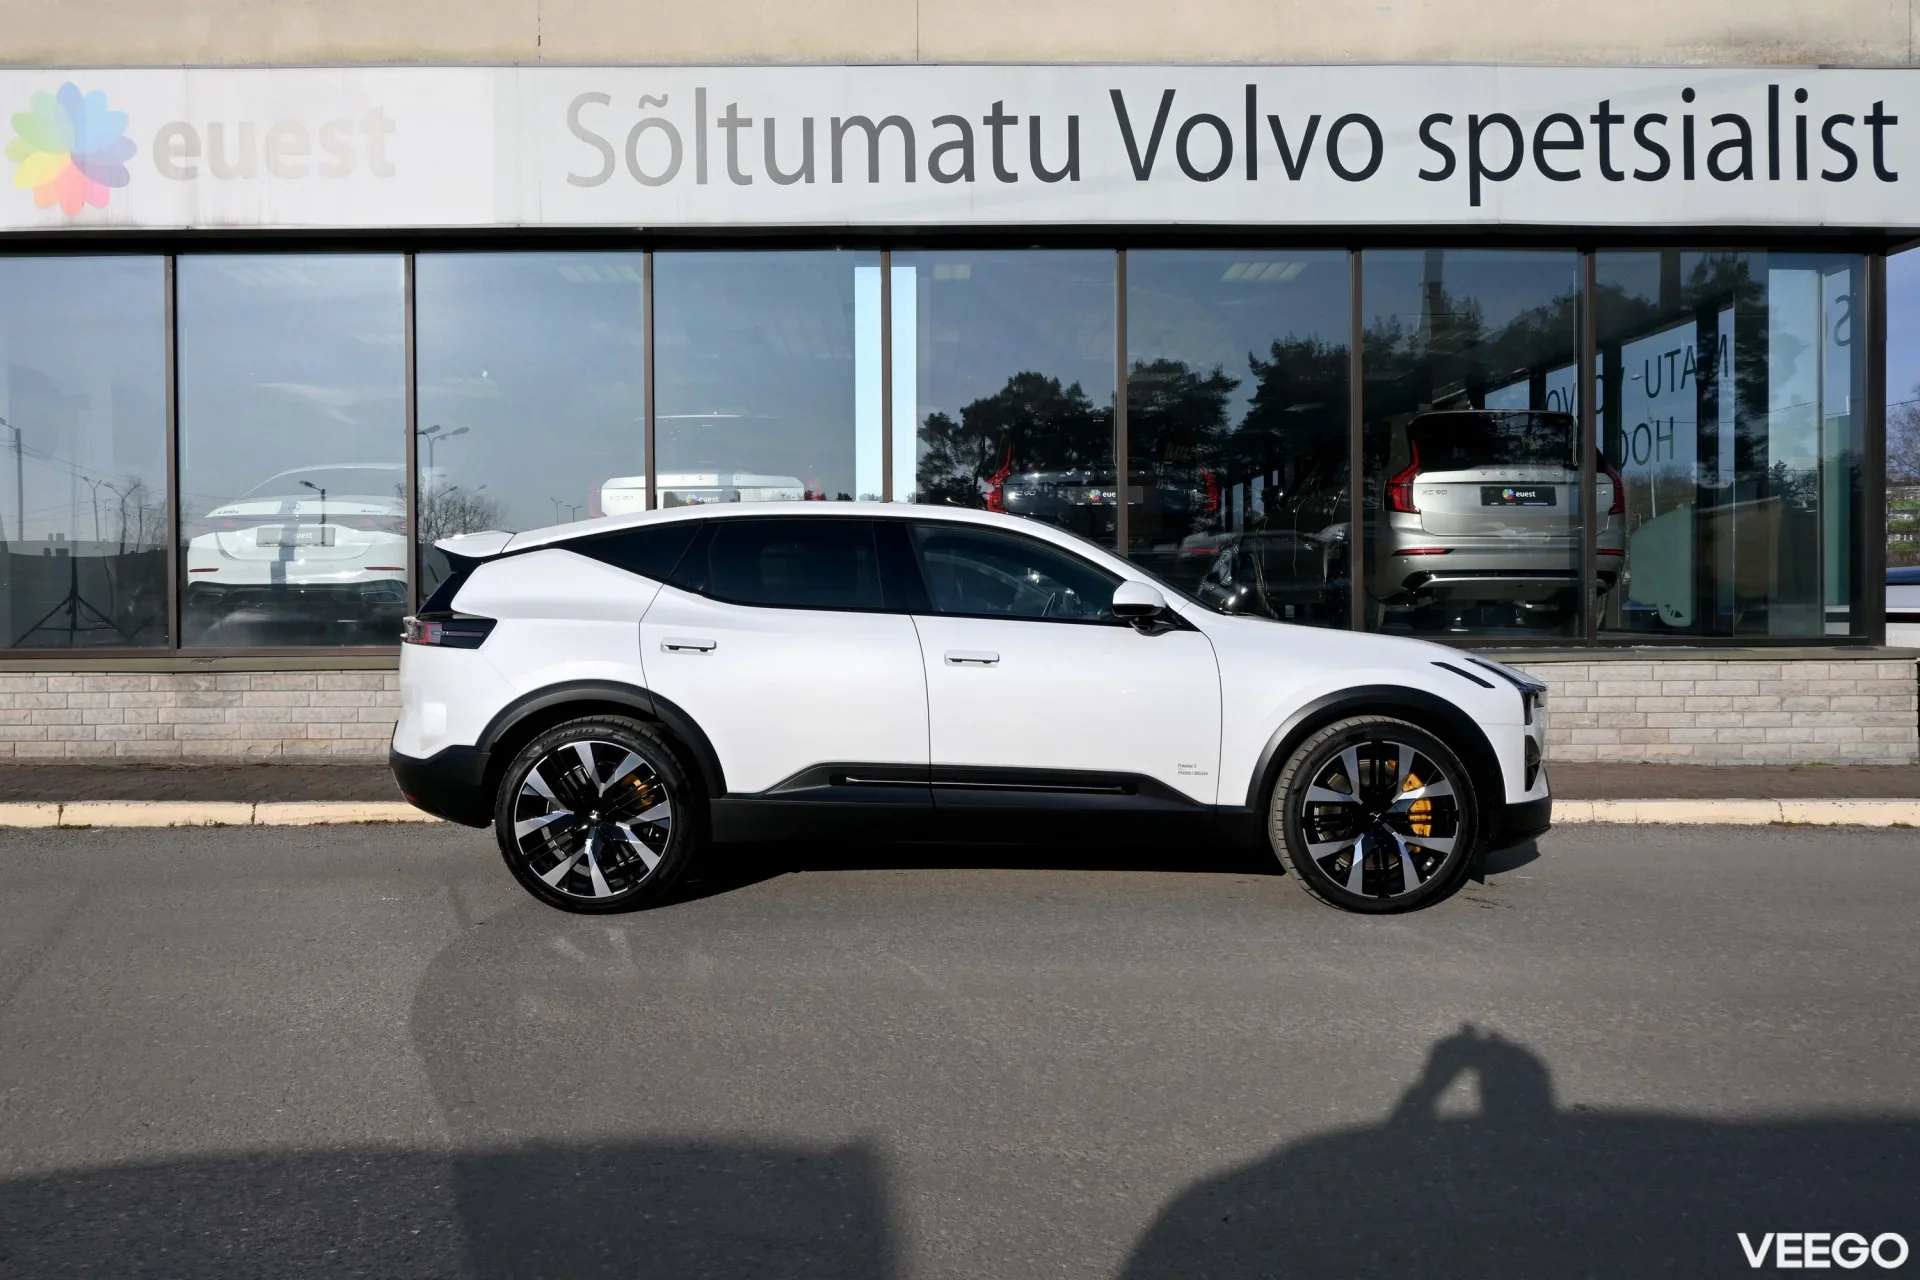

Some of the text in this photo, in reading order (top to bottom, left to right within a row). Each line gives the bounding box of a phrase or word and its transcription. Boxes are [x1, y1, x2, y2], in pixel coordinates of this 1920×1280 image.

[152, 105, 397, 179] euest
[566, 83, 1899, 208] Sõltumatu Volvo spetsialist
[1515, 490, 1536, 498] euest
